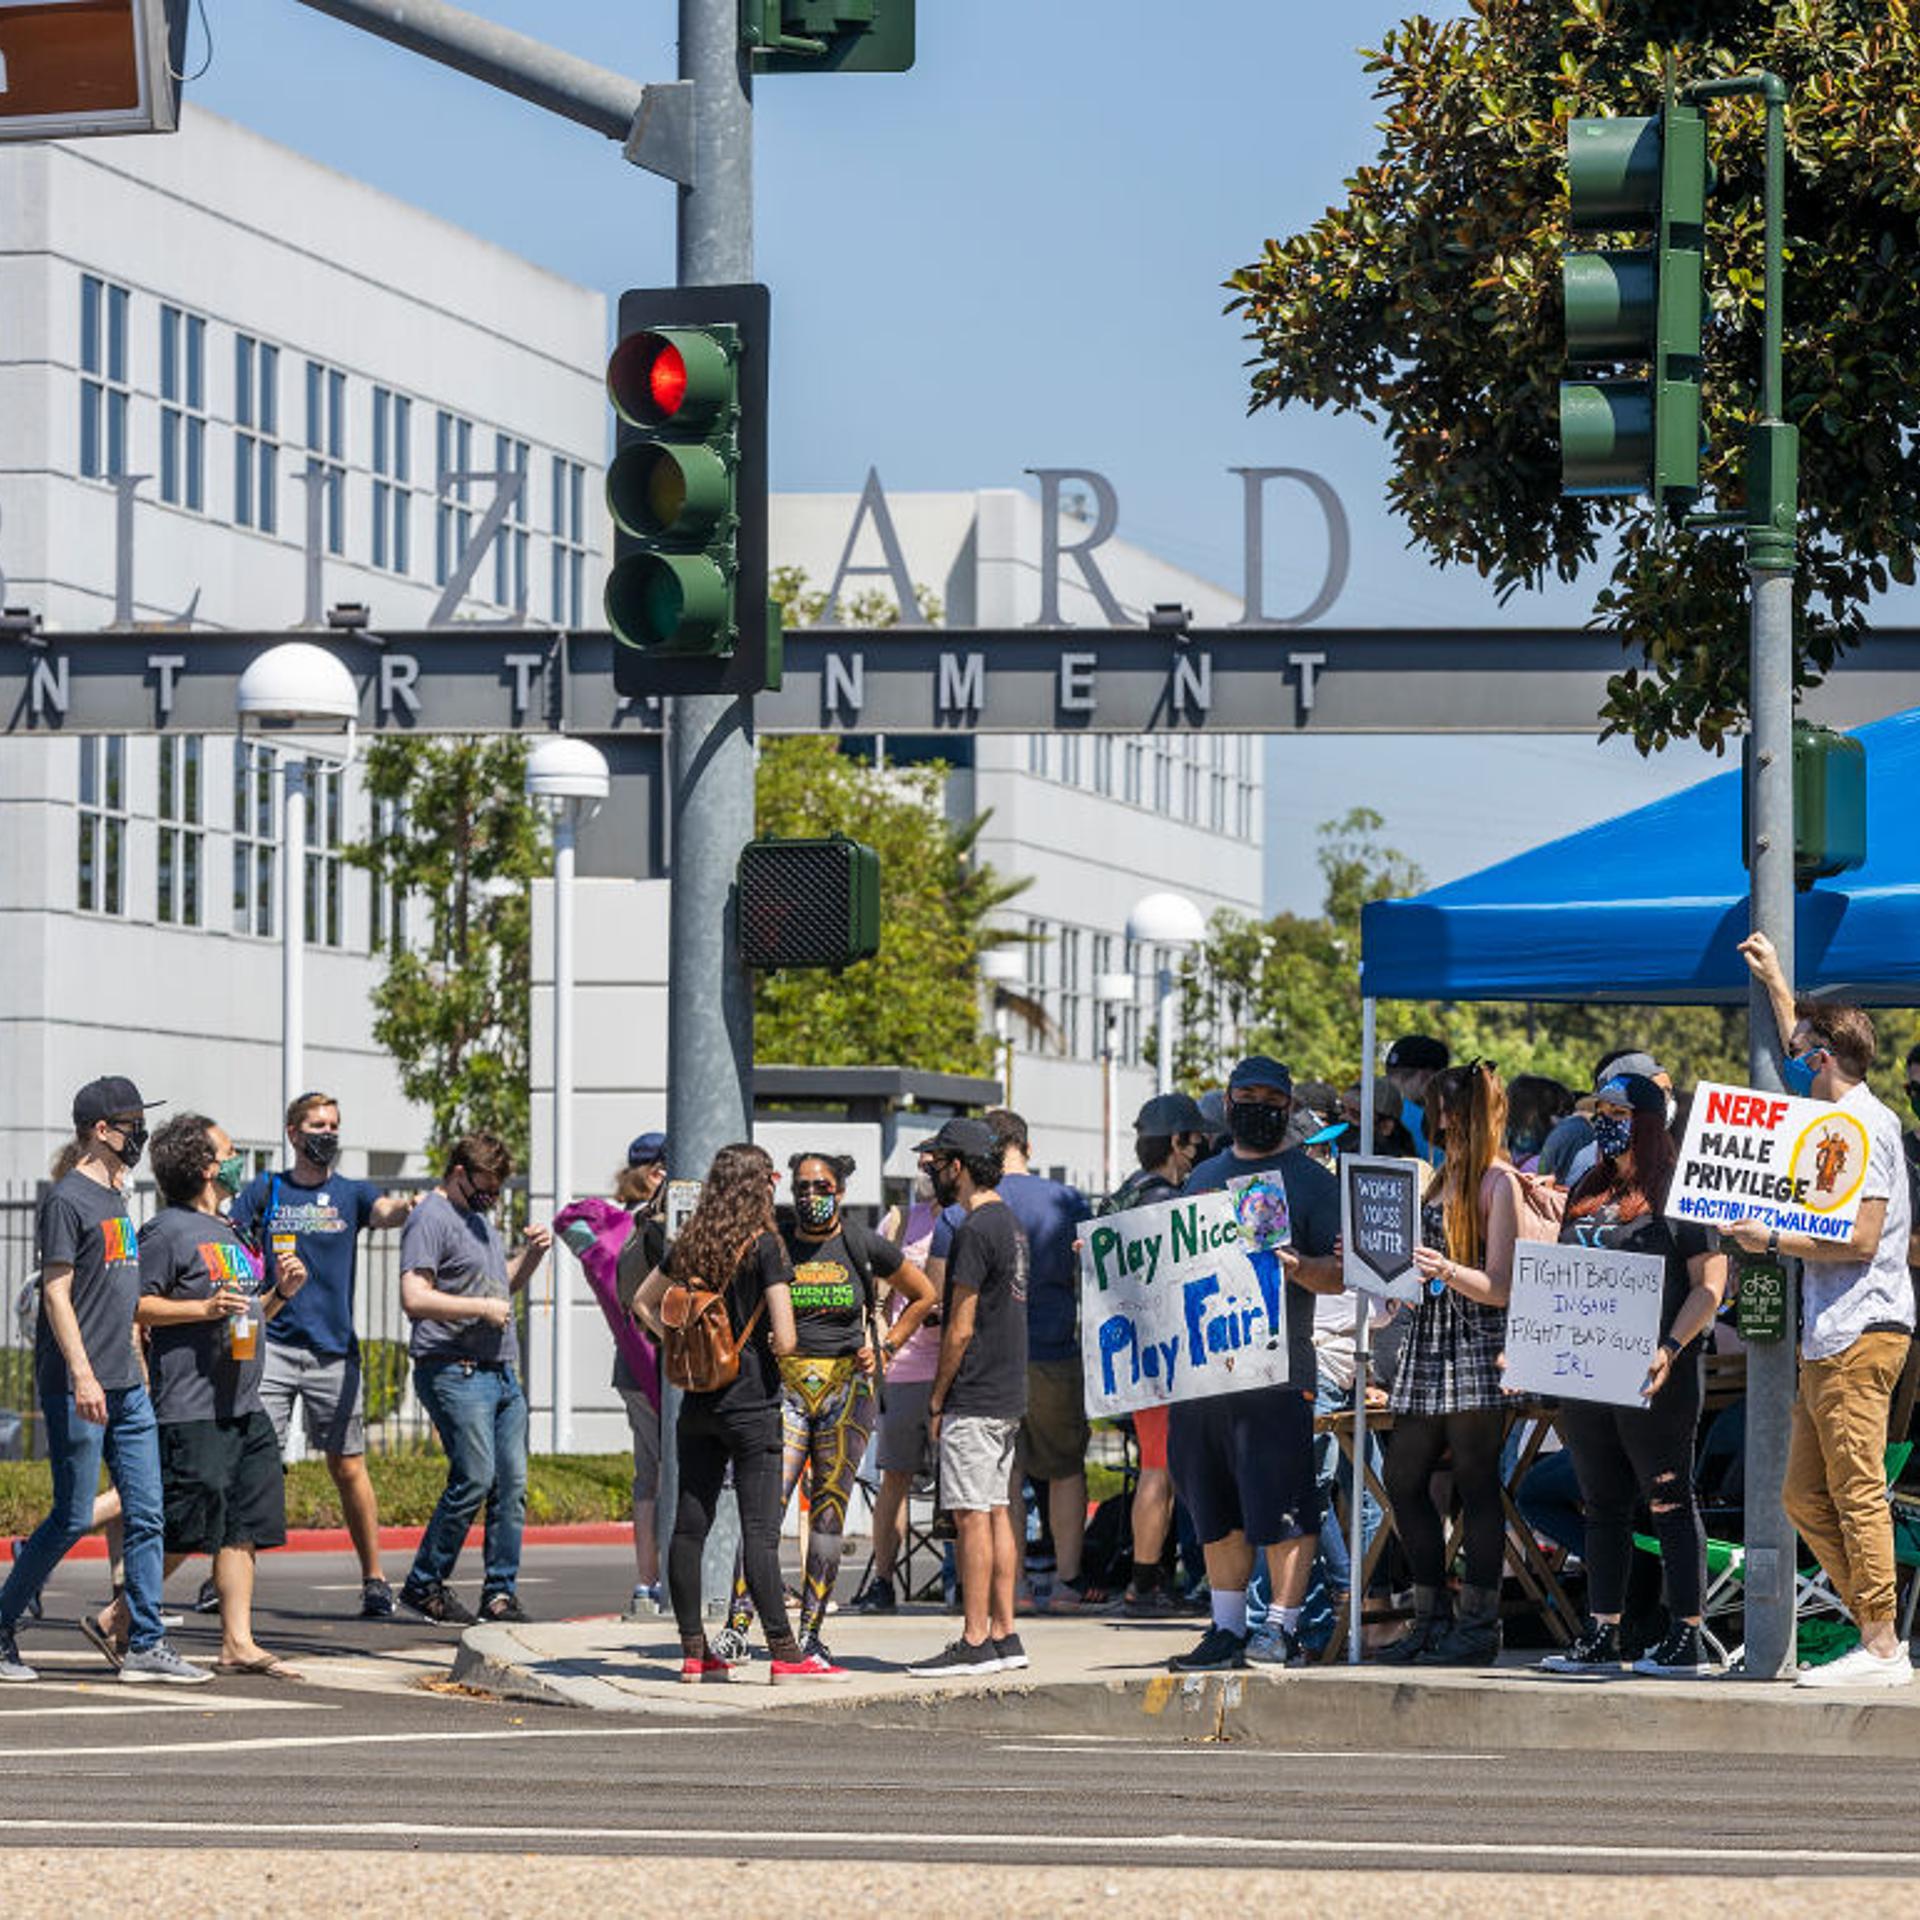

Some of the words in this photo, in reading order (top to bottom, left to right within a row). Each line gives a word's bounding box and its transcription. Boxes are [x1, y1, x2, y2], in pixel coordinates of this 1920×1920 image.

[0, 466, 1351, 627] LIZARD
[1705, 1092, 1789, 1131] NERF
[1700, 1132, 1775, 1164] MALE
[1684, 1160, 1811, 1205] PRIVILEGE
[1091, 1226, 1162, 1291] Play
[1171, 1203, 1239, 1263] Nice
[1360, 1229, 1402, 1255] MATTER
[1519, 1256, 1581, 1290] FIGHT
[1585, 1262, 1618, 1289] BAD
[1619, 1265, 1659, 1296] GUYS
[1099, 1314, 1179, 1395] Play
[1183, 1251, 1280, 1367] Fair!
[1510, 1316, 1565, 1345] FIGHT
[1568, 1324, 1607, 1347] BAD
[1609, 1330, 1651, 1356] GUYS
[1553, 1351, 1595, 1378] IRL
